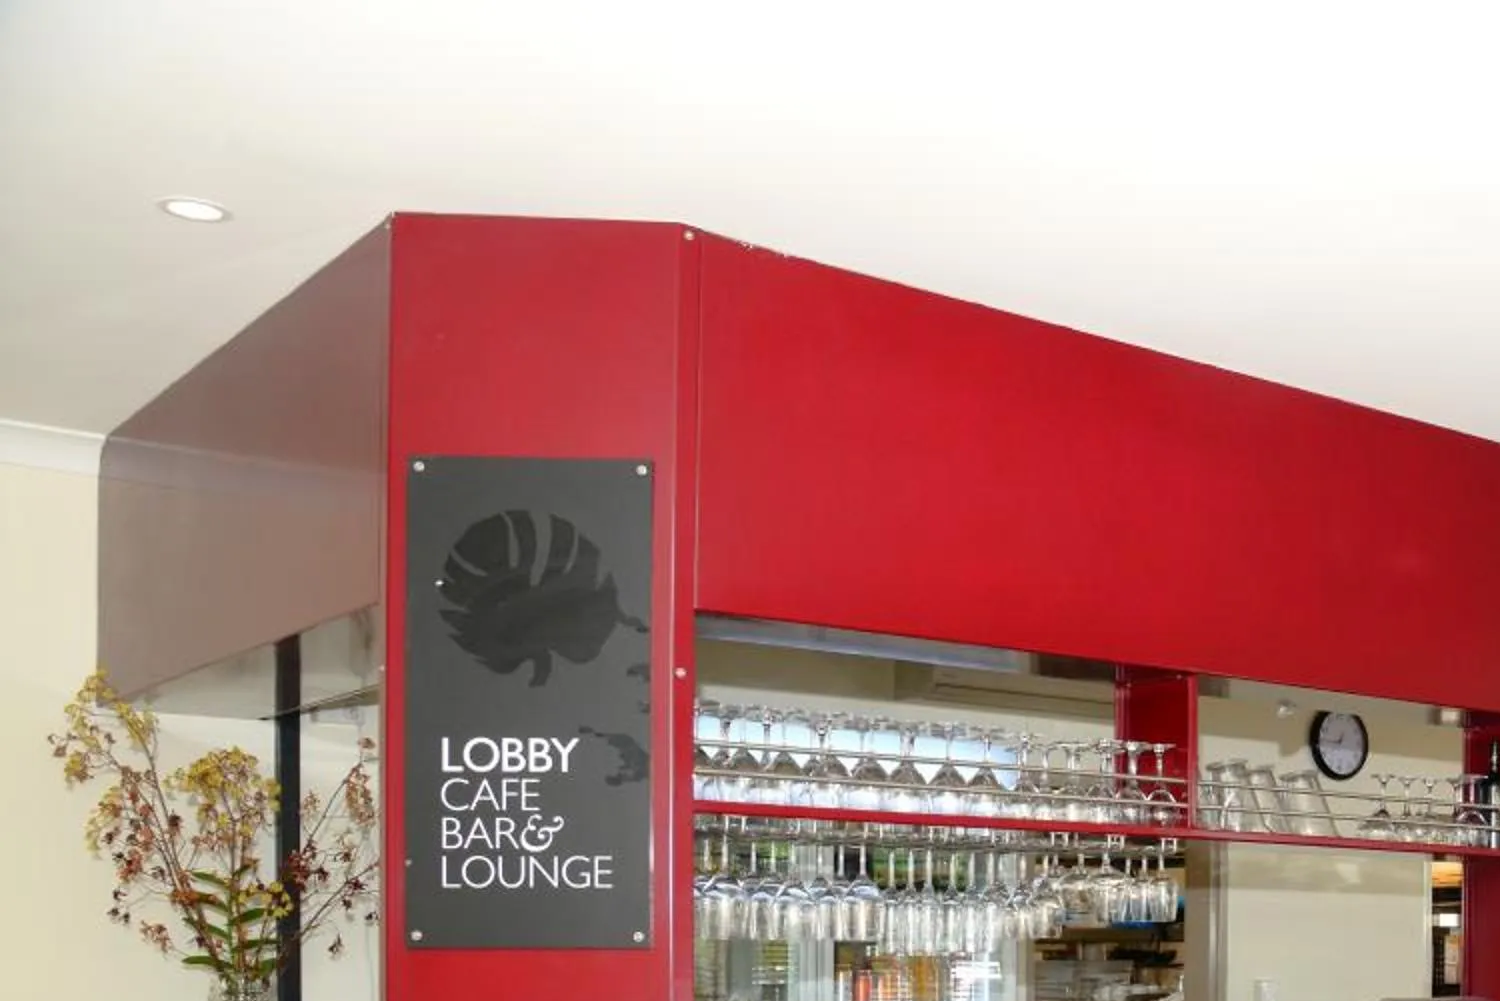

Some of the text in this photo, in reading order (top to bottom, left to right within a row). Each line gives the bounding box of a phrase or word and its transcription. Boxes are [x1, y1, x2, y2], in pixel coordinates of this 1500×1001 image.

[441, 736, 580, 773] LOBBY
[440, 777, 541, 812] CAFE
[441, 855, 613, 889] LOUNGE
